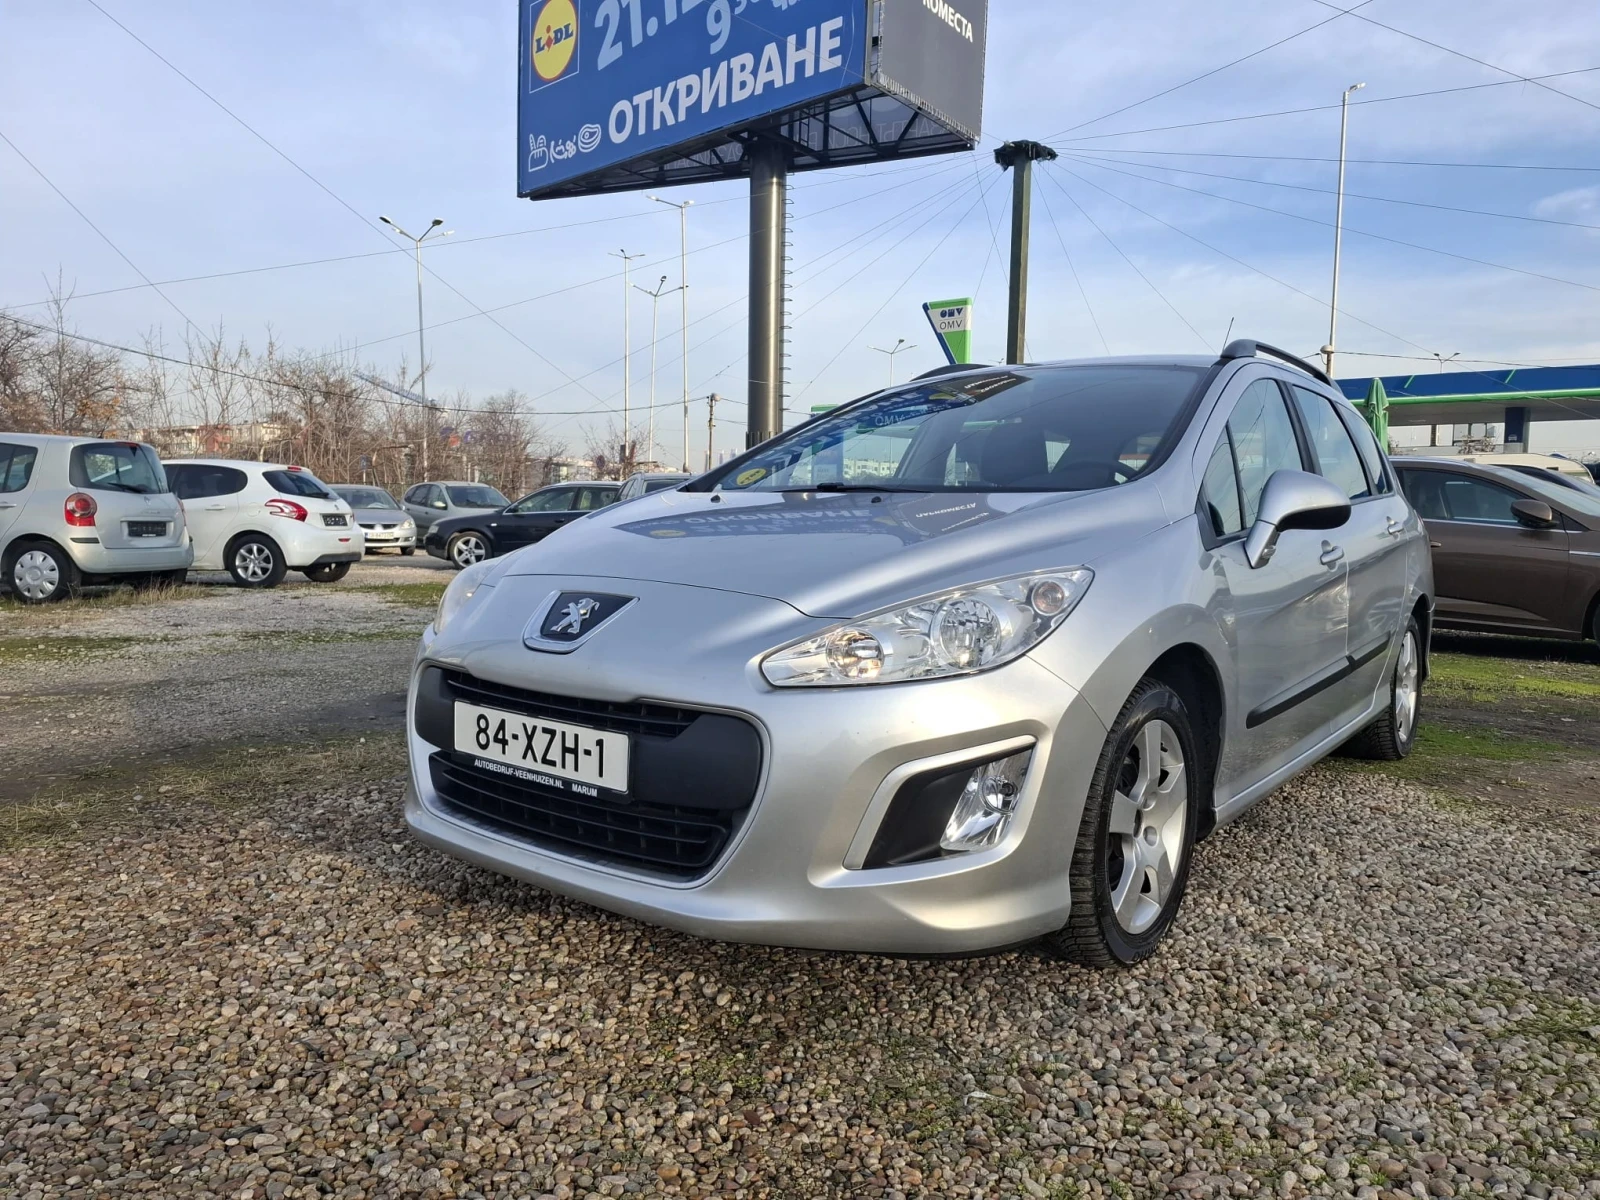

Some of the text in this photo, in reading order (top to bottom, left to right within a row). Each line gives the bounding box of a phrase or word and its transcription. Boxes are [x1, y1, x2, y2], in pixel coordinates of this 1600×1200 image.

[594, 0, 700, 71] 21.
[608, 16, 844, 144] ОТКРИВАНЕ
[940, 307, 964, 318] OMV
[940, 320, 963, 330] OMV
[475, 713, 604, 778] 84-XZH-1
[474, 758, 598, 797] AUTOBEDRIJF-VEENHUIZEN.NL MARUM
